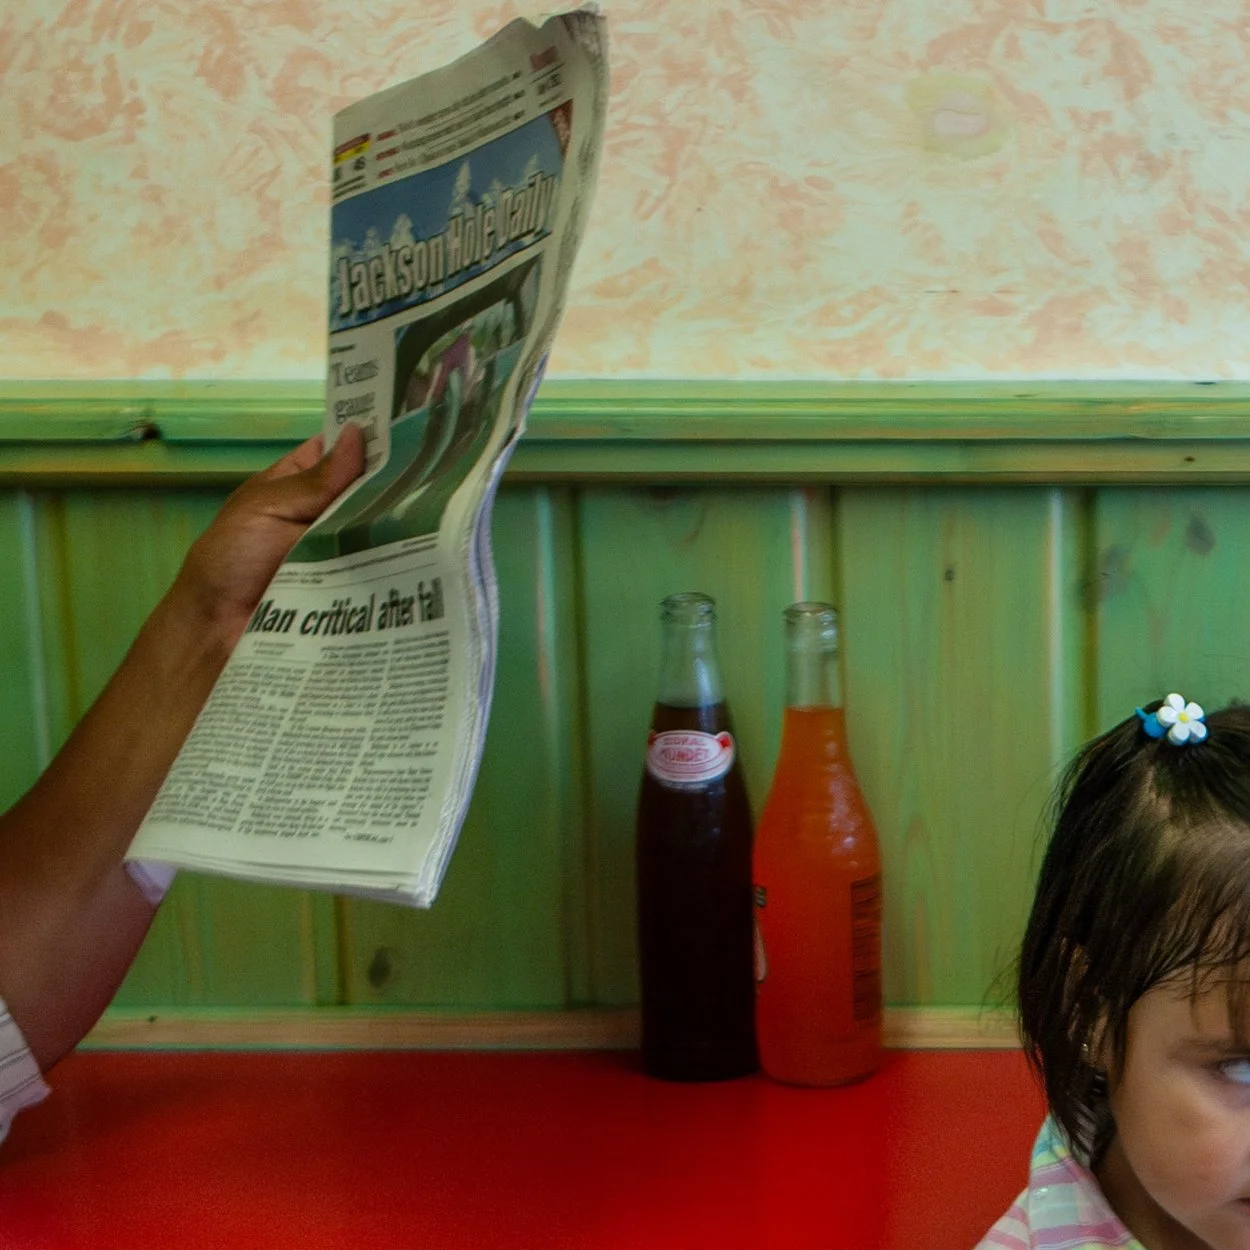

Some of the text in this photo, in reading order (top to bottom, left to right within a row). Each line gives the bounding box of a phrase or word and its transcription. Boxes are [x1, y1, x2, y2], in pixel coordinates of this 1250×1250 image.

[337, 170, 558, 318] Jackson Hole Daily
[300, 593, 376, 636] critical
[377, 587, 415, 631] after
